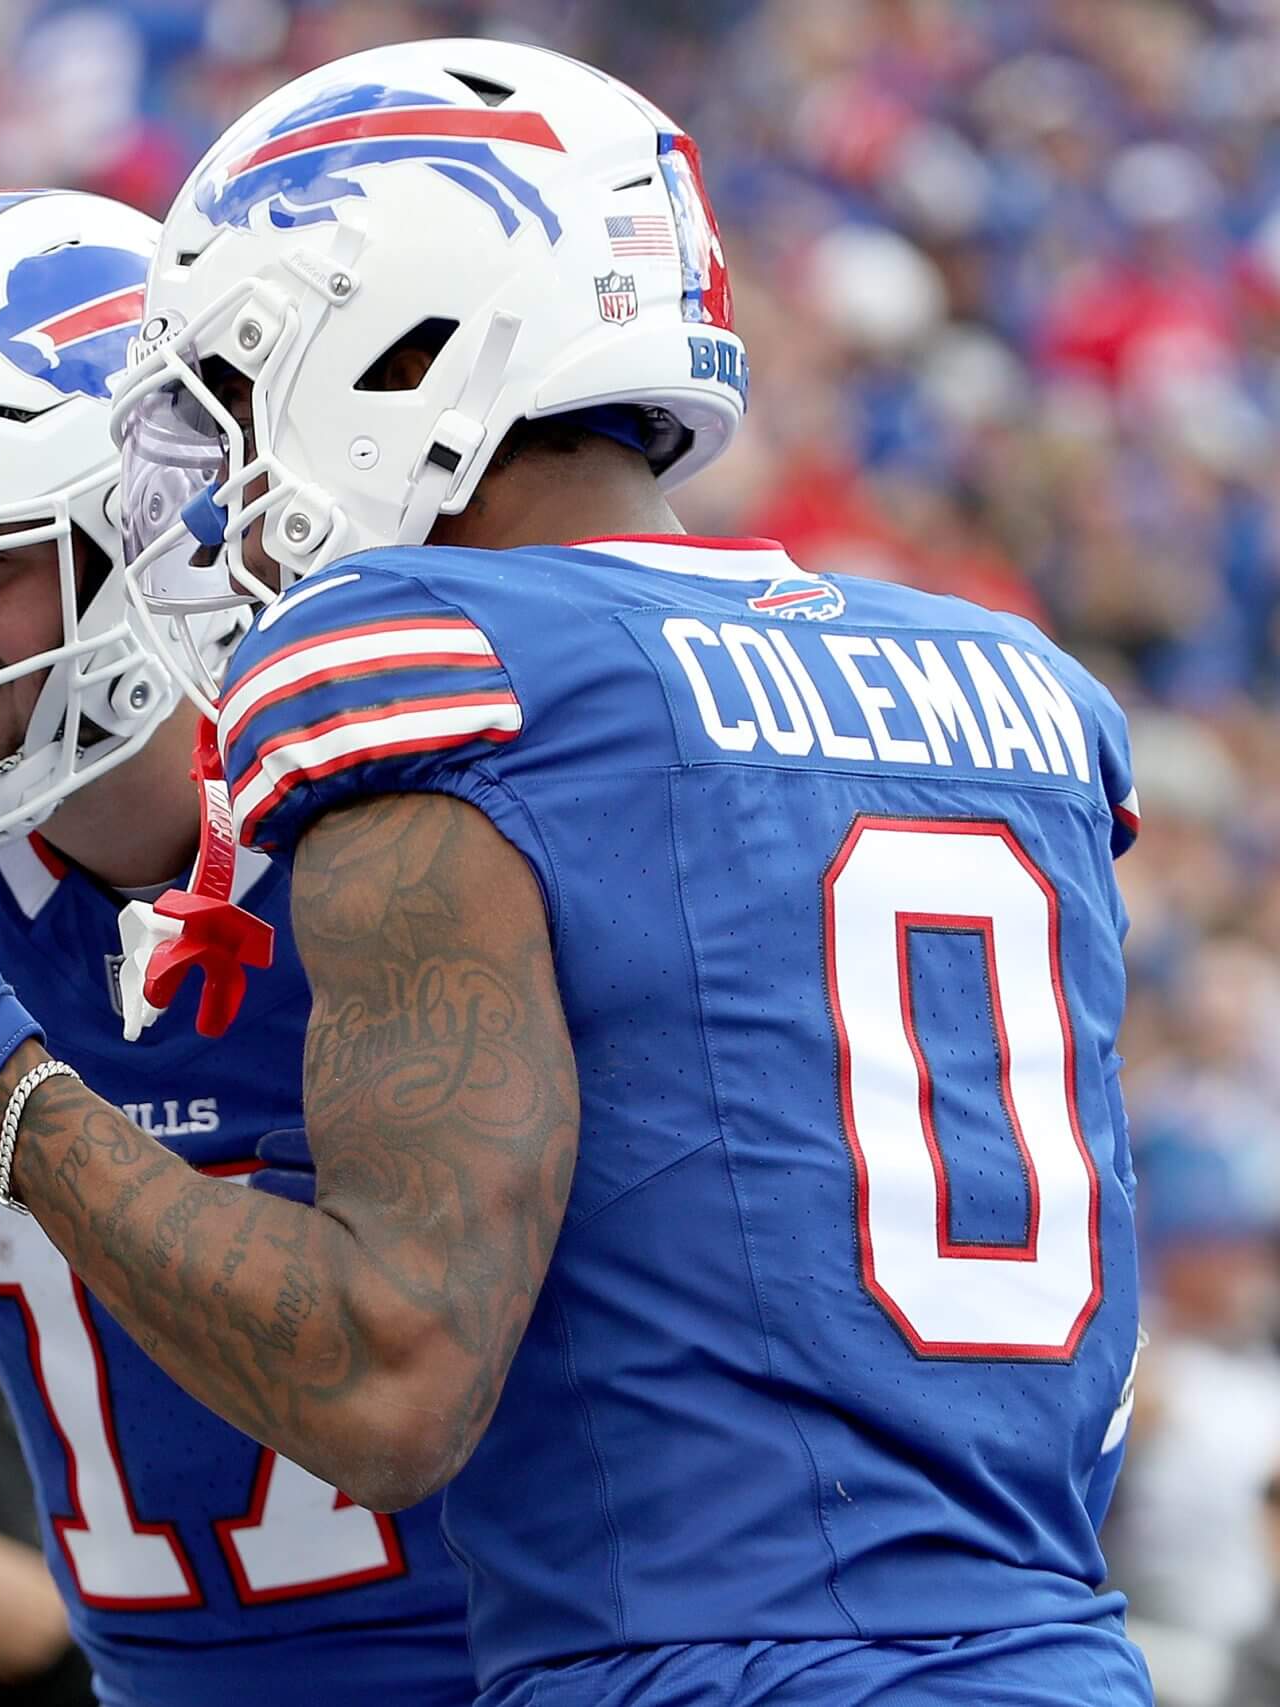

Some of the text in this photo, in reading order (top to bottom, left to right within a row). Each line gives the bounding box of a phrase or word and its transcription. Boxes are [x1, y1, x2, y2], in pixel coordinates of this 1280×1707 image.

[602, 294, 634, 320] NFL
[661, 617, 1091, 784] COLEMAN
[118, 1097, 220, 1137] ILLS
[819, 810, 1104, 1364] 0
